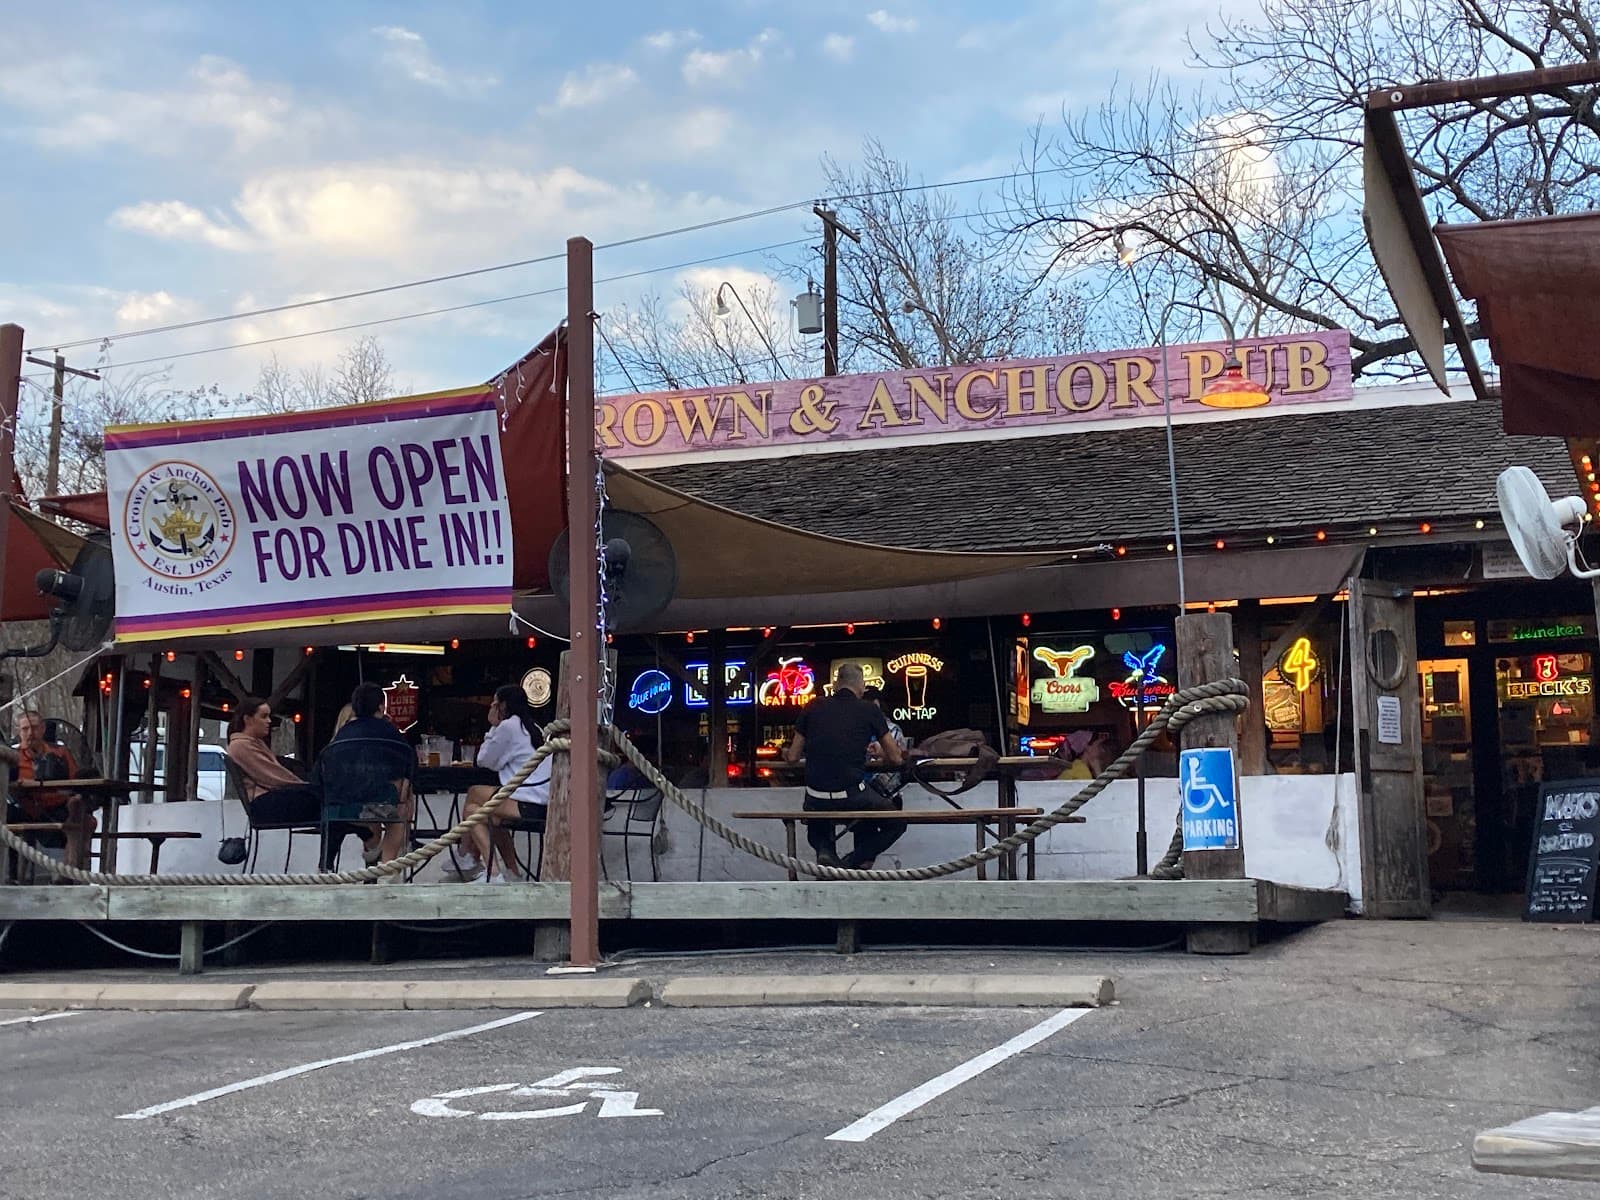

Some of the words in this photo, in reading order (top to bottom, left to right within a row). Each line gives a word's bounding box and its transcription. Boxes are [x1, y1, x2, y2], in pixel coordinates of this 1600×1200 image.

[594, 389, 772, 450] ROWN
[789, 383, 839, 436] &
[856, 356, 1165, 431] ANCHOR
[1180, 340, 1332, 404] PUB
[236, 449, 355, 523] NOW
[367, 433, 499, 511] OPEN
[129, 479, 150, 538] Crown
[149, 470, 162, 485] &
[165, 466, 216, 499] Anchor
[213, 497, 231, 530] Pub
[252, 527, 332, 584] FOR
[336, 515, 433, 576] DINE
[438, 510, 505, 568] IN!!
[152, 554, 186, 574] Est.
[189, 548, 221, 574] 1987
[142, 575, 194, 597] Austin,
[198, 566, 234, 592] Texas
[887, 652, 945, 674] GUINNESS
[1283, 637, 1317, 692] 4
[1046, 680, 1082, 694] Coors
[1507, 676, 1591, 697] BECK'S
[390, 695, 416, 704] LONE
[390, 706, 416, 715] STAR
[765, 694, 785, 706] FAT
[1184, 818, 1234, 839] PARKING
